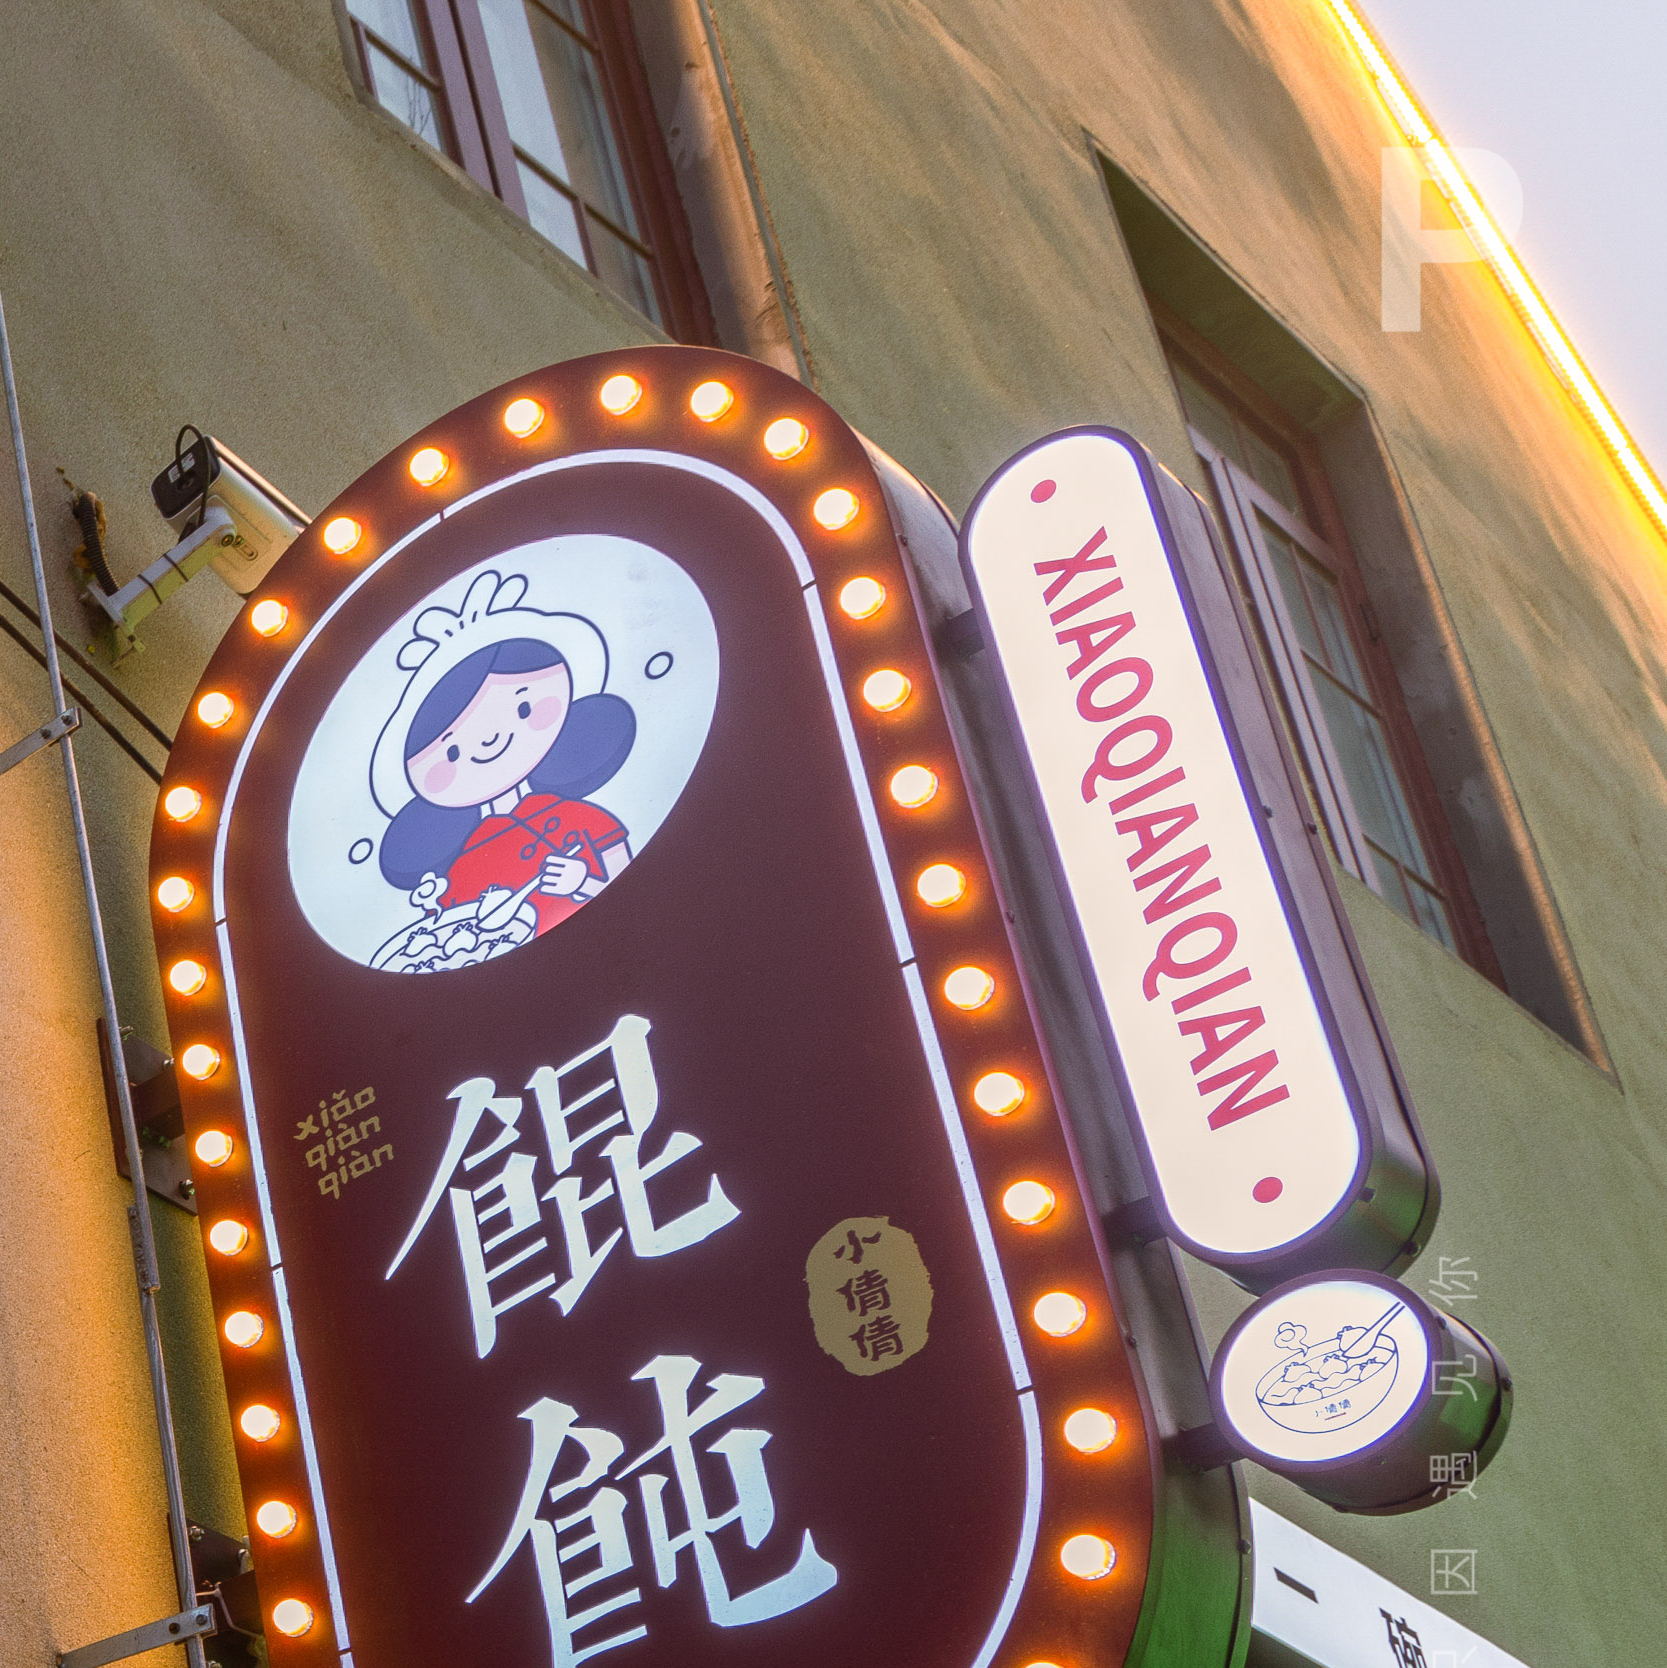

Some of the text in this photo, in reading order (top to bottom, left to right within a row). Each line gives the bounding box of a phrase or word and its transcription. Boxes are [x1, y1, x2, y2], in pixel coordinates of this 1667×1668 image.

[1033, 526, 1290, 1131] XIAOQIANQIAN
[305, 1116, 381, 1171] qiàn
[318, 1143, 394, 1200] qiàn
[833, 1229, 904, 1361] 小倩倩
